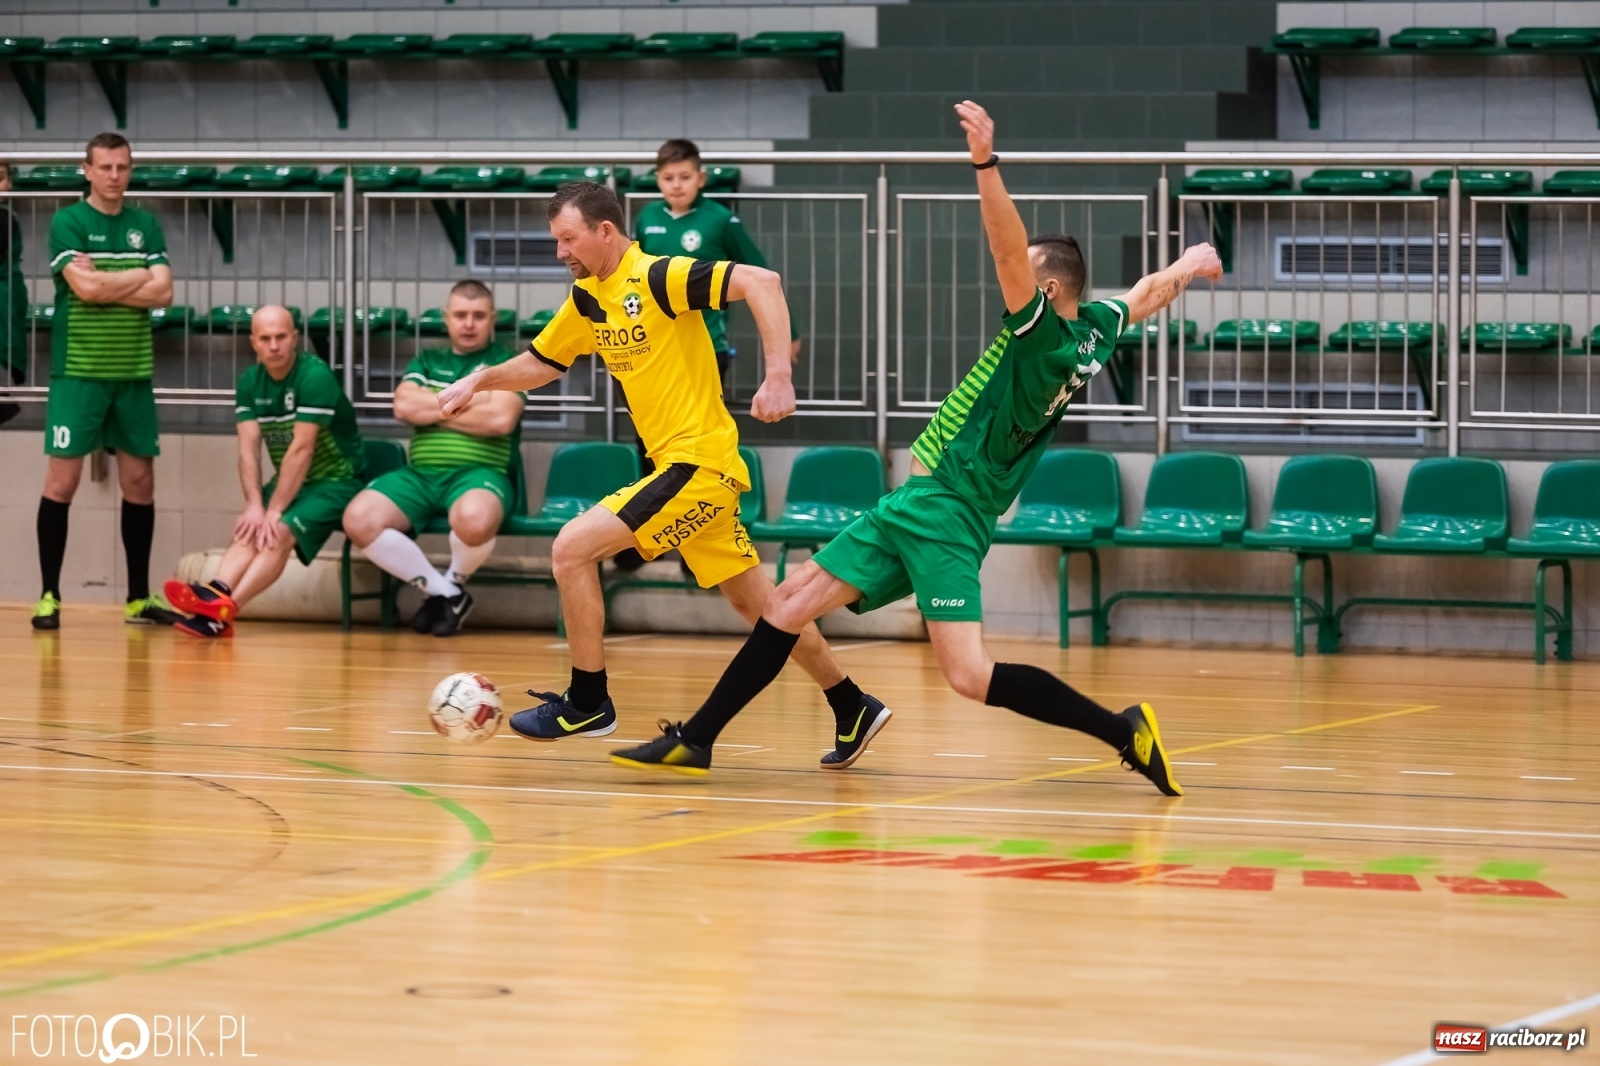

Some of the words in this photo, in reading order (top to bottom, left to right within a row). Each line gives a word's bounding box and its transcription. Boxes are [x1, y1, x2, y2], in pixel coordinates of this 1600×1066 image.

[595, 324, 647, 347] ERZOG
[53, 425, 71, 449] 10
[652, 500, 714, 545] PRACA
[662, 506, 725, 549] USTRIA
